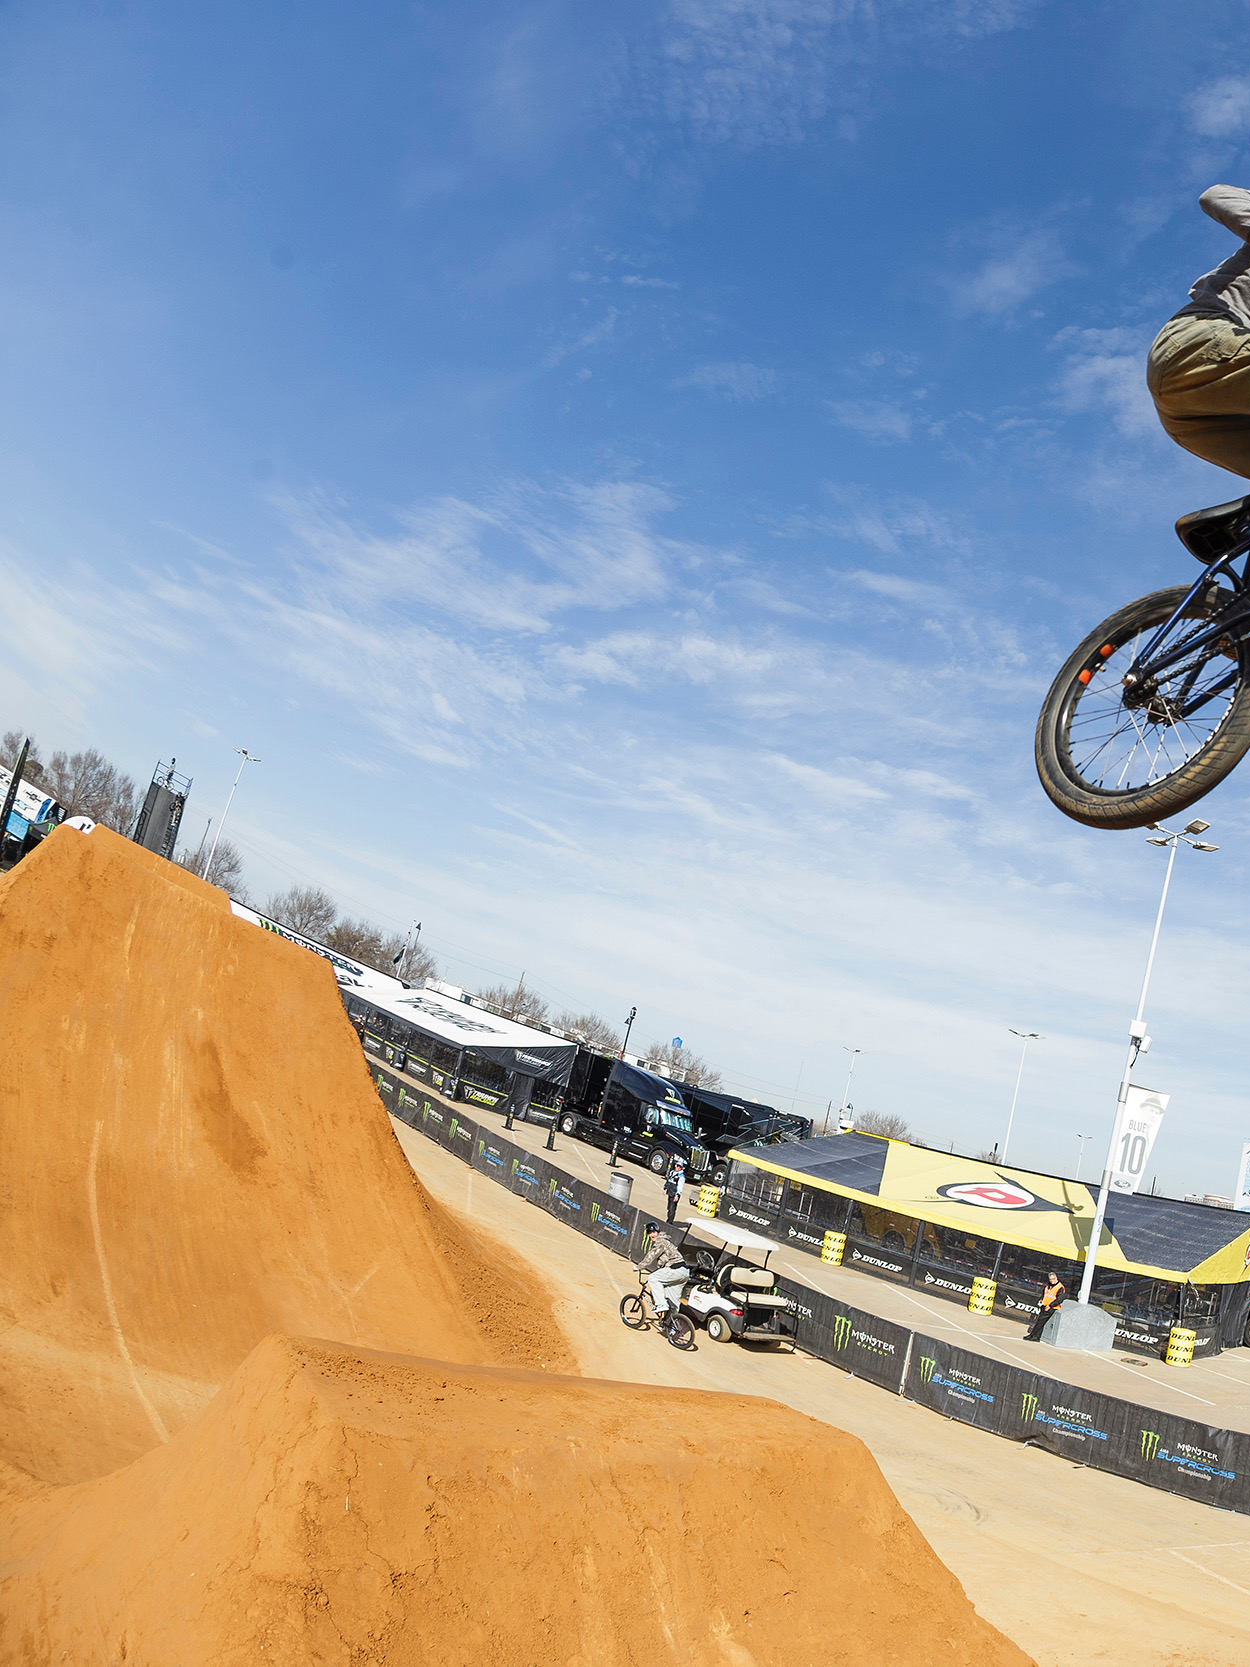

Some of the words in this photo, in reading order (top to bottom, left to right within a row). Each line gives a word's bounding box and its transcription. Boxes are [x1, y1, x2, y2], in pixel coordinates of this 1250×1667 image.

[1129, 1120, 1147, 1133] BLUE
[1121, 1133, 1146, 1174] 10
[736, 1209, 770, 1227] DUNLOP
[797, 1231, 824, 1247] DUNLO
[861, 1254, 903, 1273] DUNLOP
[935, 1278, 972, 1295] DUNLO
[777, 1296, 812, 1318] ONSTER
[1015, 1302, 1041, 1315] DUN
[851, 1329, 895, 1354] MONSTER
[1115, 1329, 1159, 1344] UNLOP
[857, 1342, 888, 1357] ENERGY
[948, 1368, 981, 1385] MONSTER
[931, 1375, 994, 1403] SUPERCROSS
[1052, 1405, 1092, 1422] MONSTER
[1035, 1413, 1108, 1440] SUPERCROSS
[1177, 1442, 1218, 1461] MONSTER
[1182, 1452, 1212, 1463] ENERGY
[1156, 1451, 1236, 1479] SUPERCROSS
[1177, 1466, 1211, 1481] Championship
